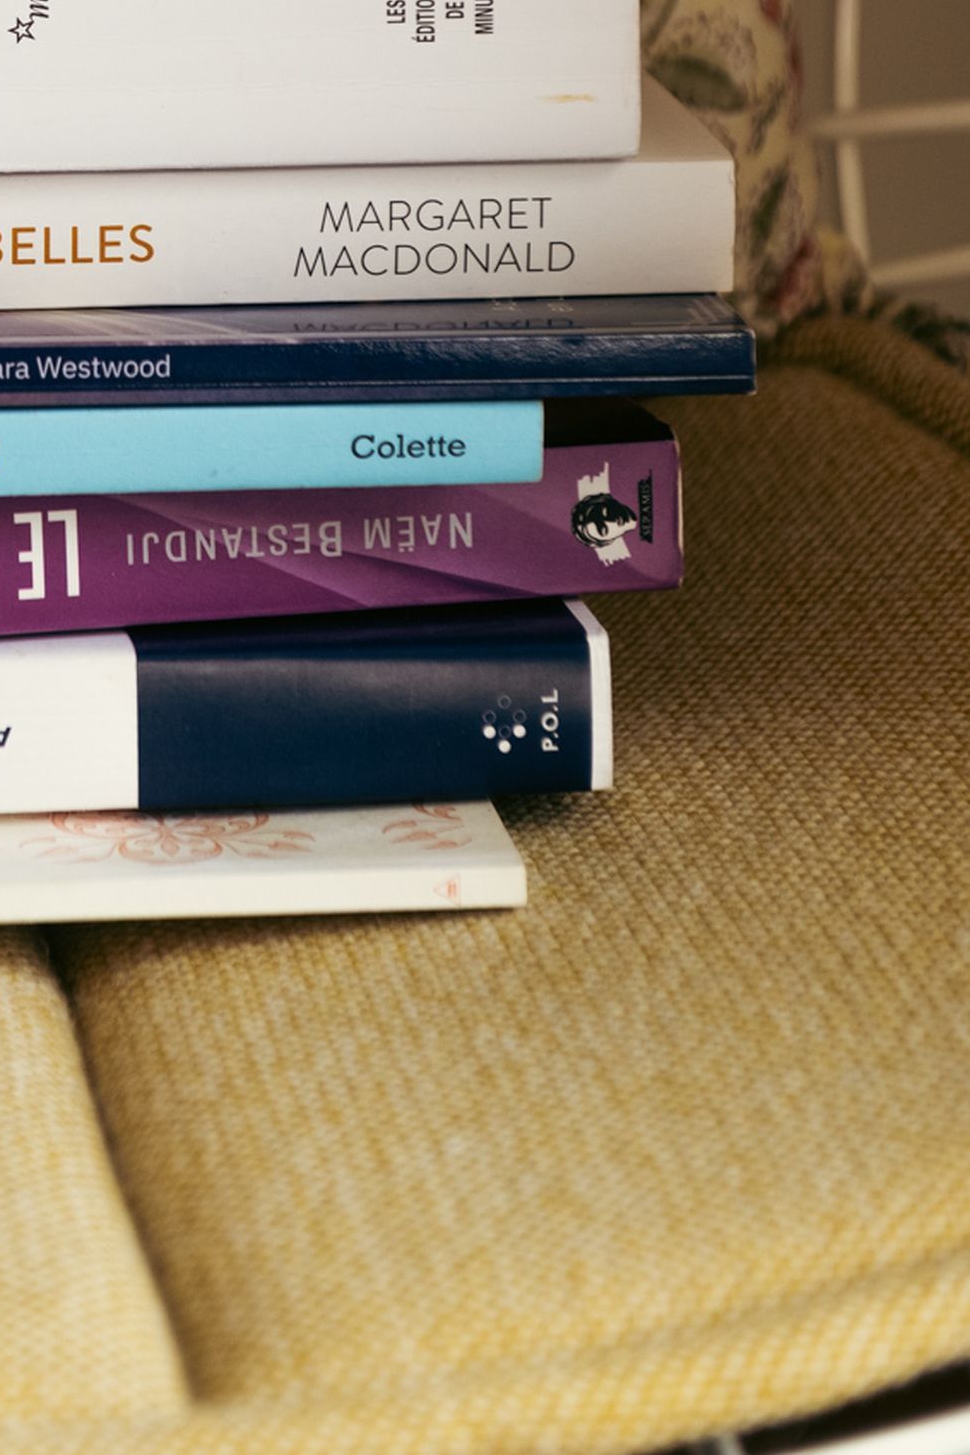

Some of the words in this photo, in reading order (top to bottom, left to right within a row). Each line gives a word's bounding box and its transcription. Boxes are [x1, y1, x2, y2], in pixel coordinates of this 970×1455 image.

[386, 0, 406, 24] LES
[445, 1, 465, 19] DE
[319, 197, 552, 233] MARGARET
[293, 241, 575, 277] MACDONALD
[36, 354, 171, 379] Westwood
[350, 433, 466, 460] Colette
[127, 521, 342, 566] BESTANDJI
[364, 512, 473, 553] NAËM
[13, 509, 81, 601] LE
